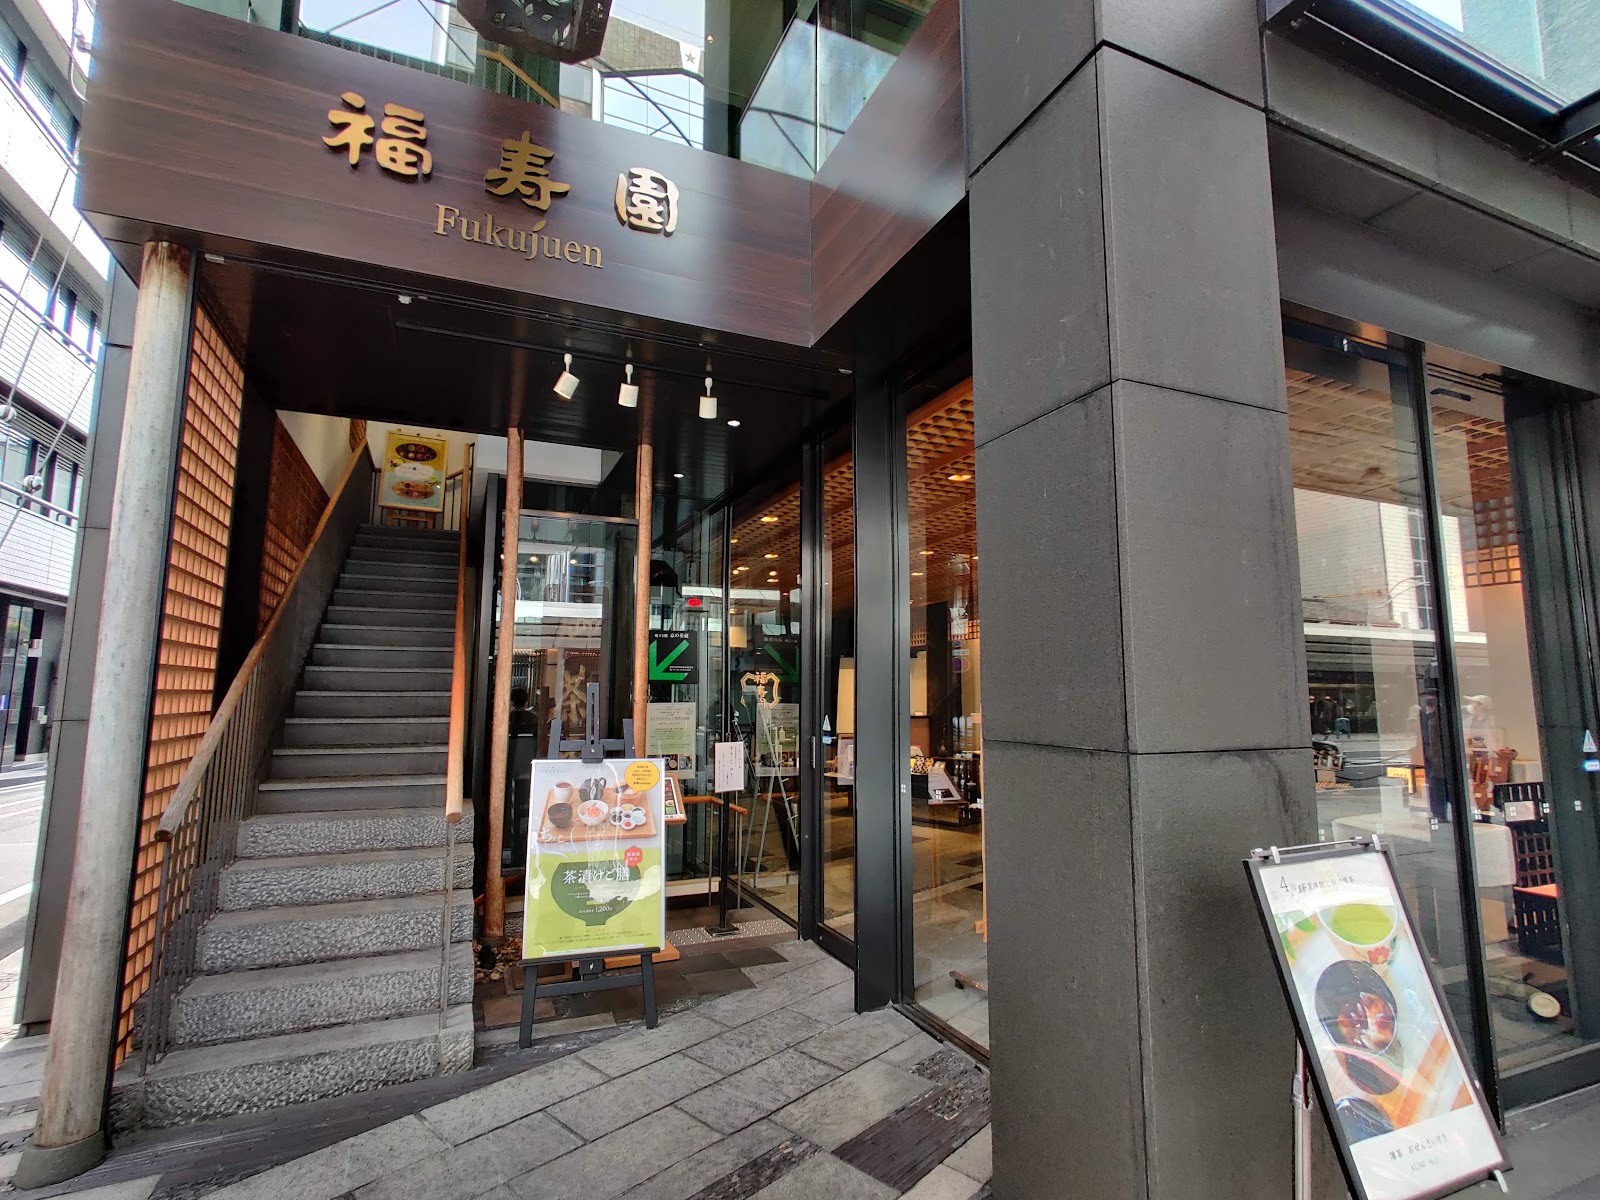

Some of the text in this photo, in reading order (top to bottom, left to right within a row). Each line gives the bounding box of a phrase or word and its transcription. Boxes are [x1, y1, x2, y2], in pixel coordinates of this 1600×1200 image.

[321, 91, 680, 237] 福寿園
[434, 203, 604, 268] Fukujuen
